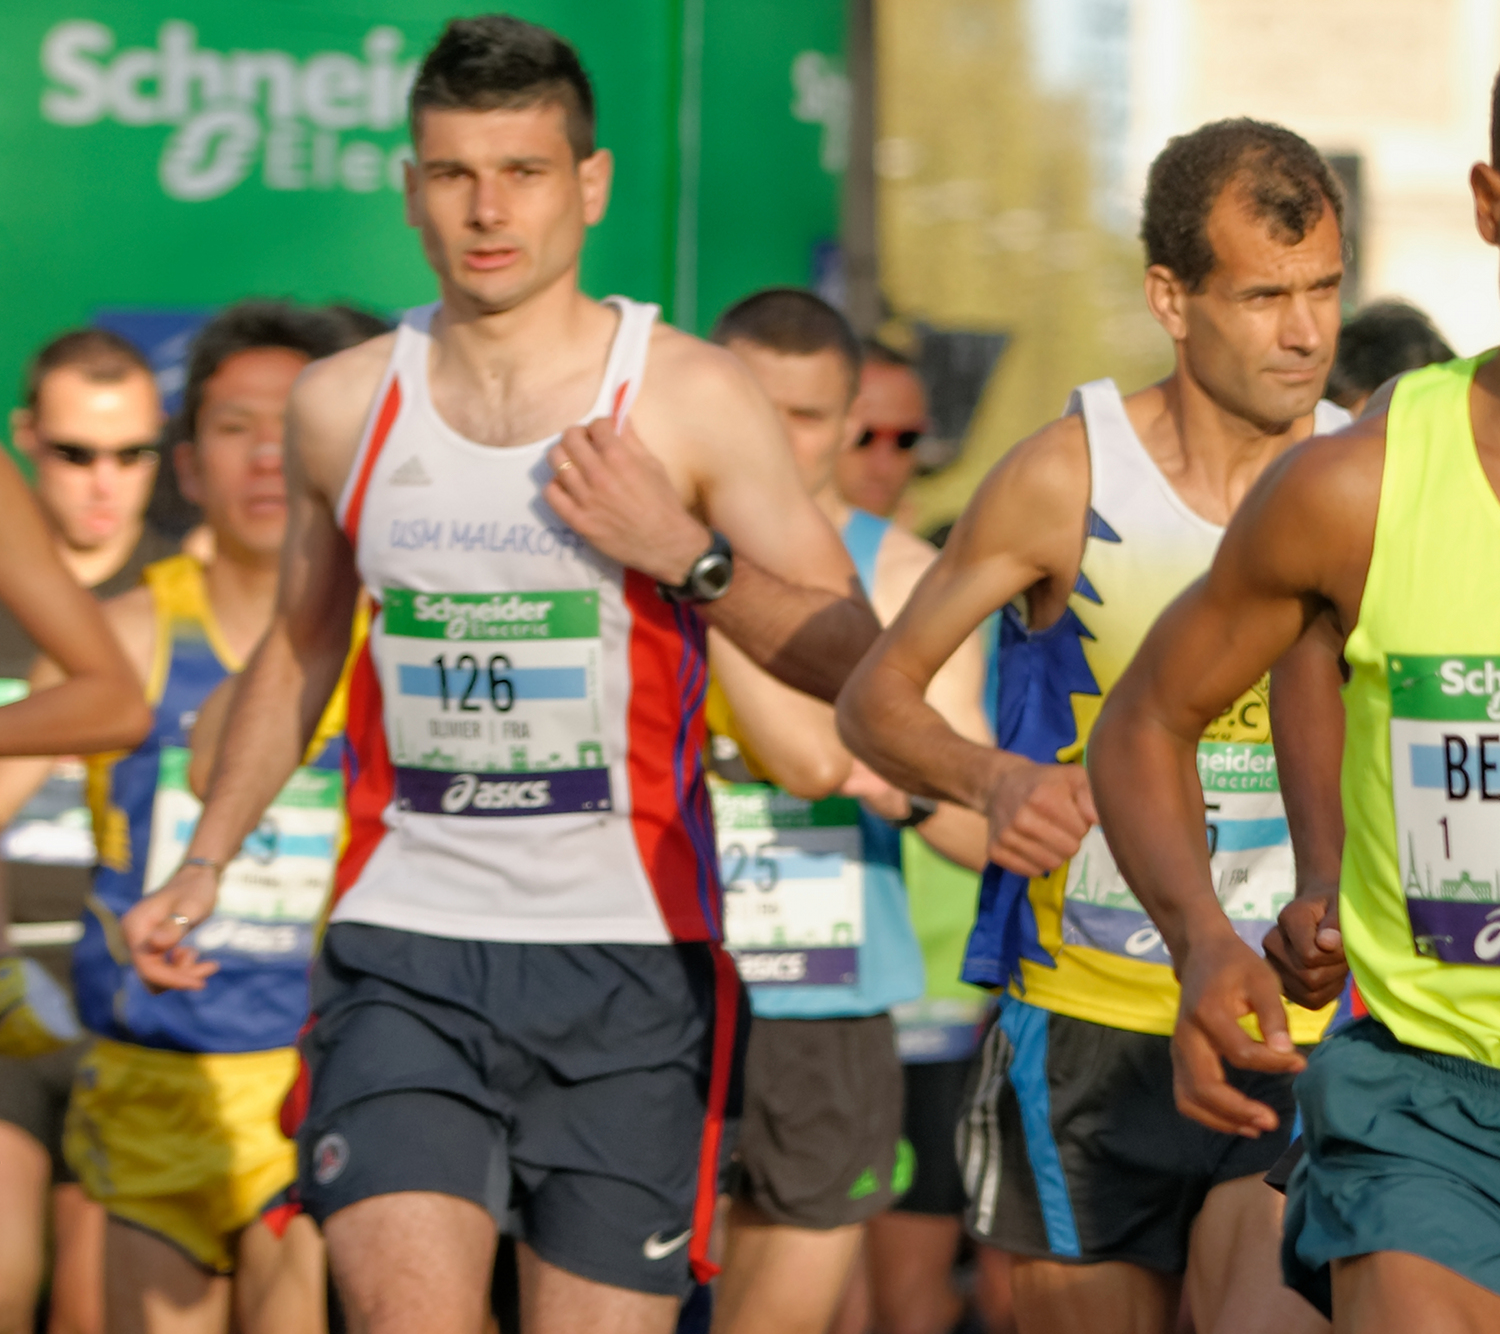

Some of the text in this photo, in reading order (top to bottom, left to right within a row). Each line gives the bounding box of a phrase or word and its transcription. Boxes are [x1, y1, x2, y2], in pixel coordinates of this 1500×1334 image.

[41, 17, 418, 131] Schnei
[413, 594, 553, 621] Schneider
[470, 621, 549, 636] Electric
[432, 653, 516, 713] 126
[502, 720, 531, 739] FRA
[471, 780, 550, 808] asics
[1438, 816, 1450, 860] 1
[1229, 868, 1248, 885] FRA
